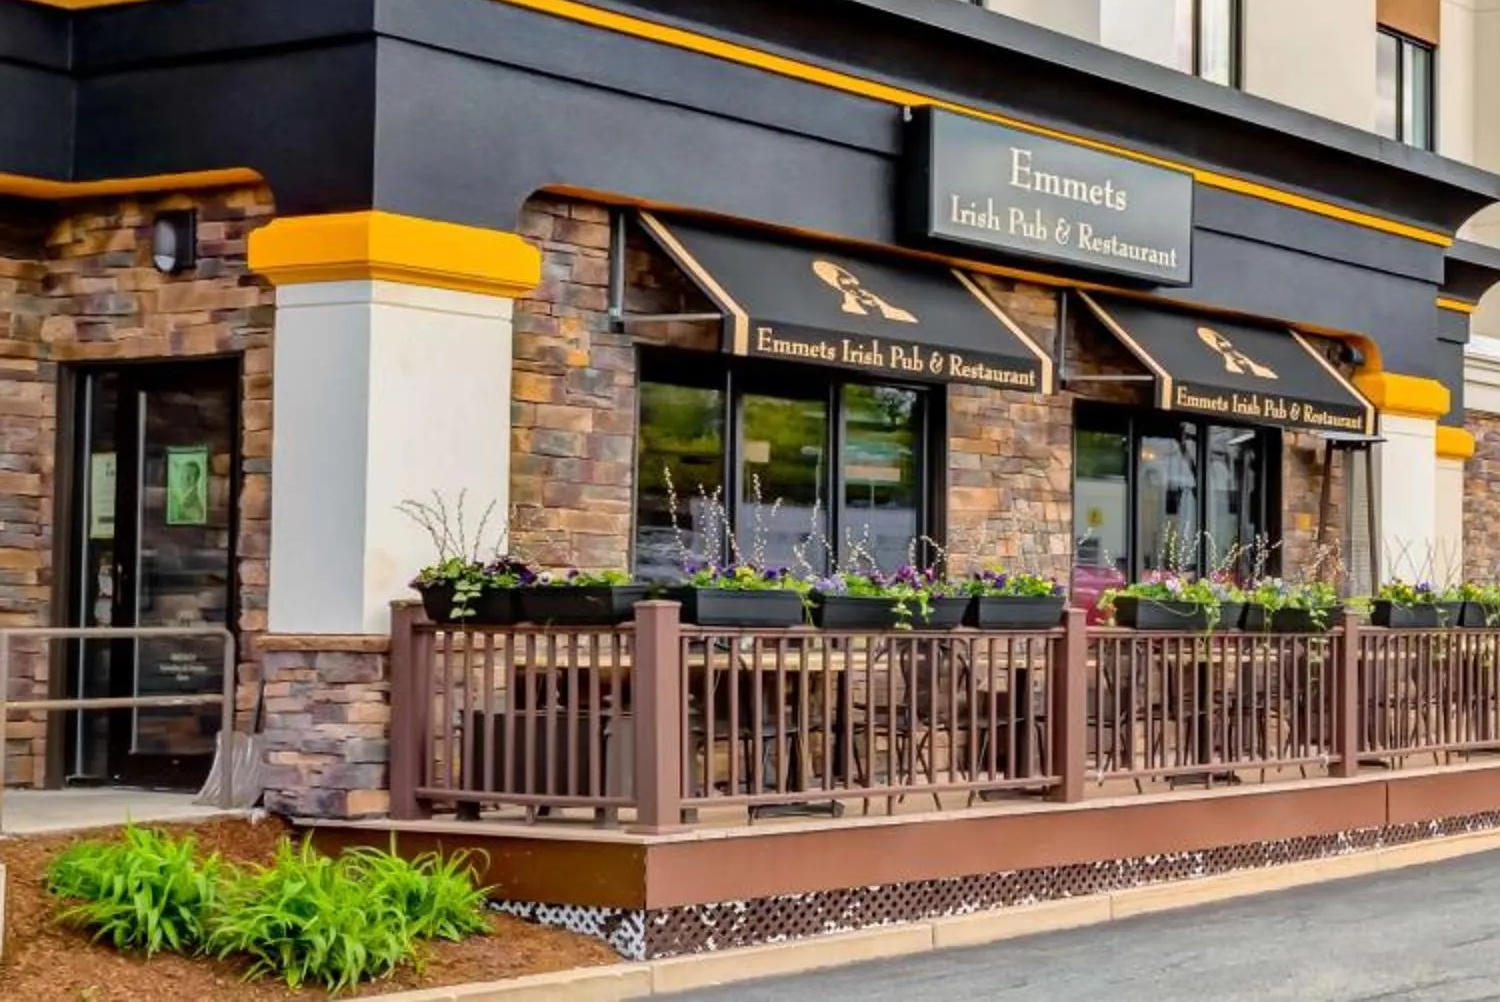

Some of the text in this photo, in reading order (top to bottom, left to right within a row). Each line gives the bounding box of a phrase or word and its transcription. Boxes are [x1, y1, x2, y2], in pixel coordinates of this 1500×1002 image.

[1008, 147, 1128, 211] Emmets
[950, 195, 1177, 268] Irish Pub & Restaurant
[756, 327, 1035, 386] Emmets Irish Pub & Restaurant
[1176, 386, 1363, 429] Emmets Irish Pub & Restaurant
